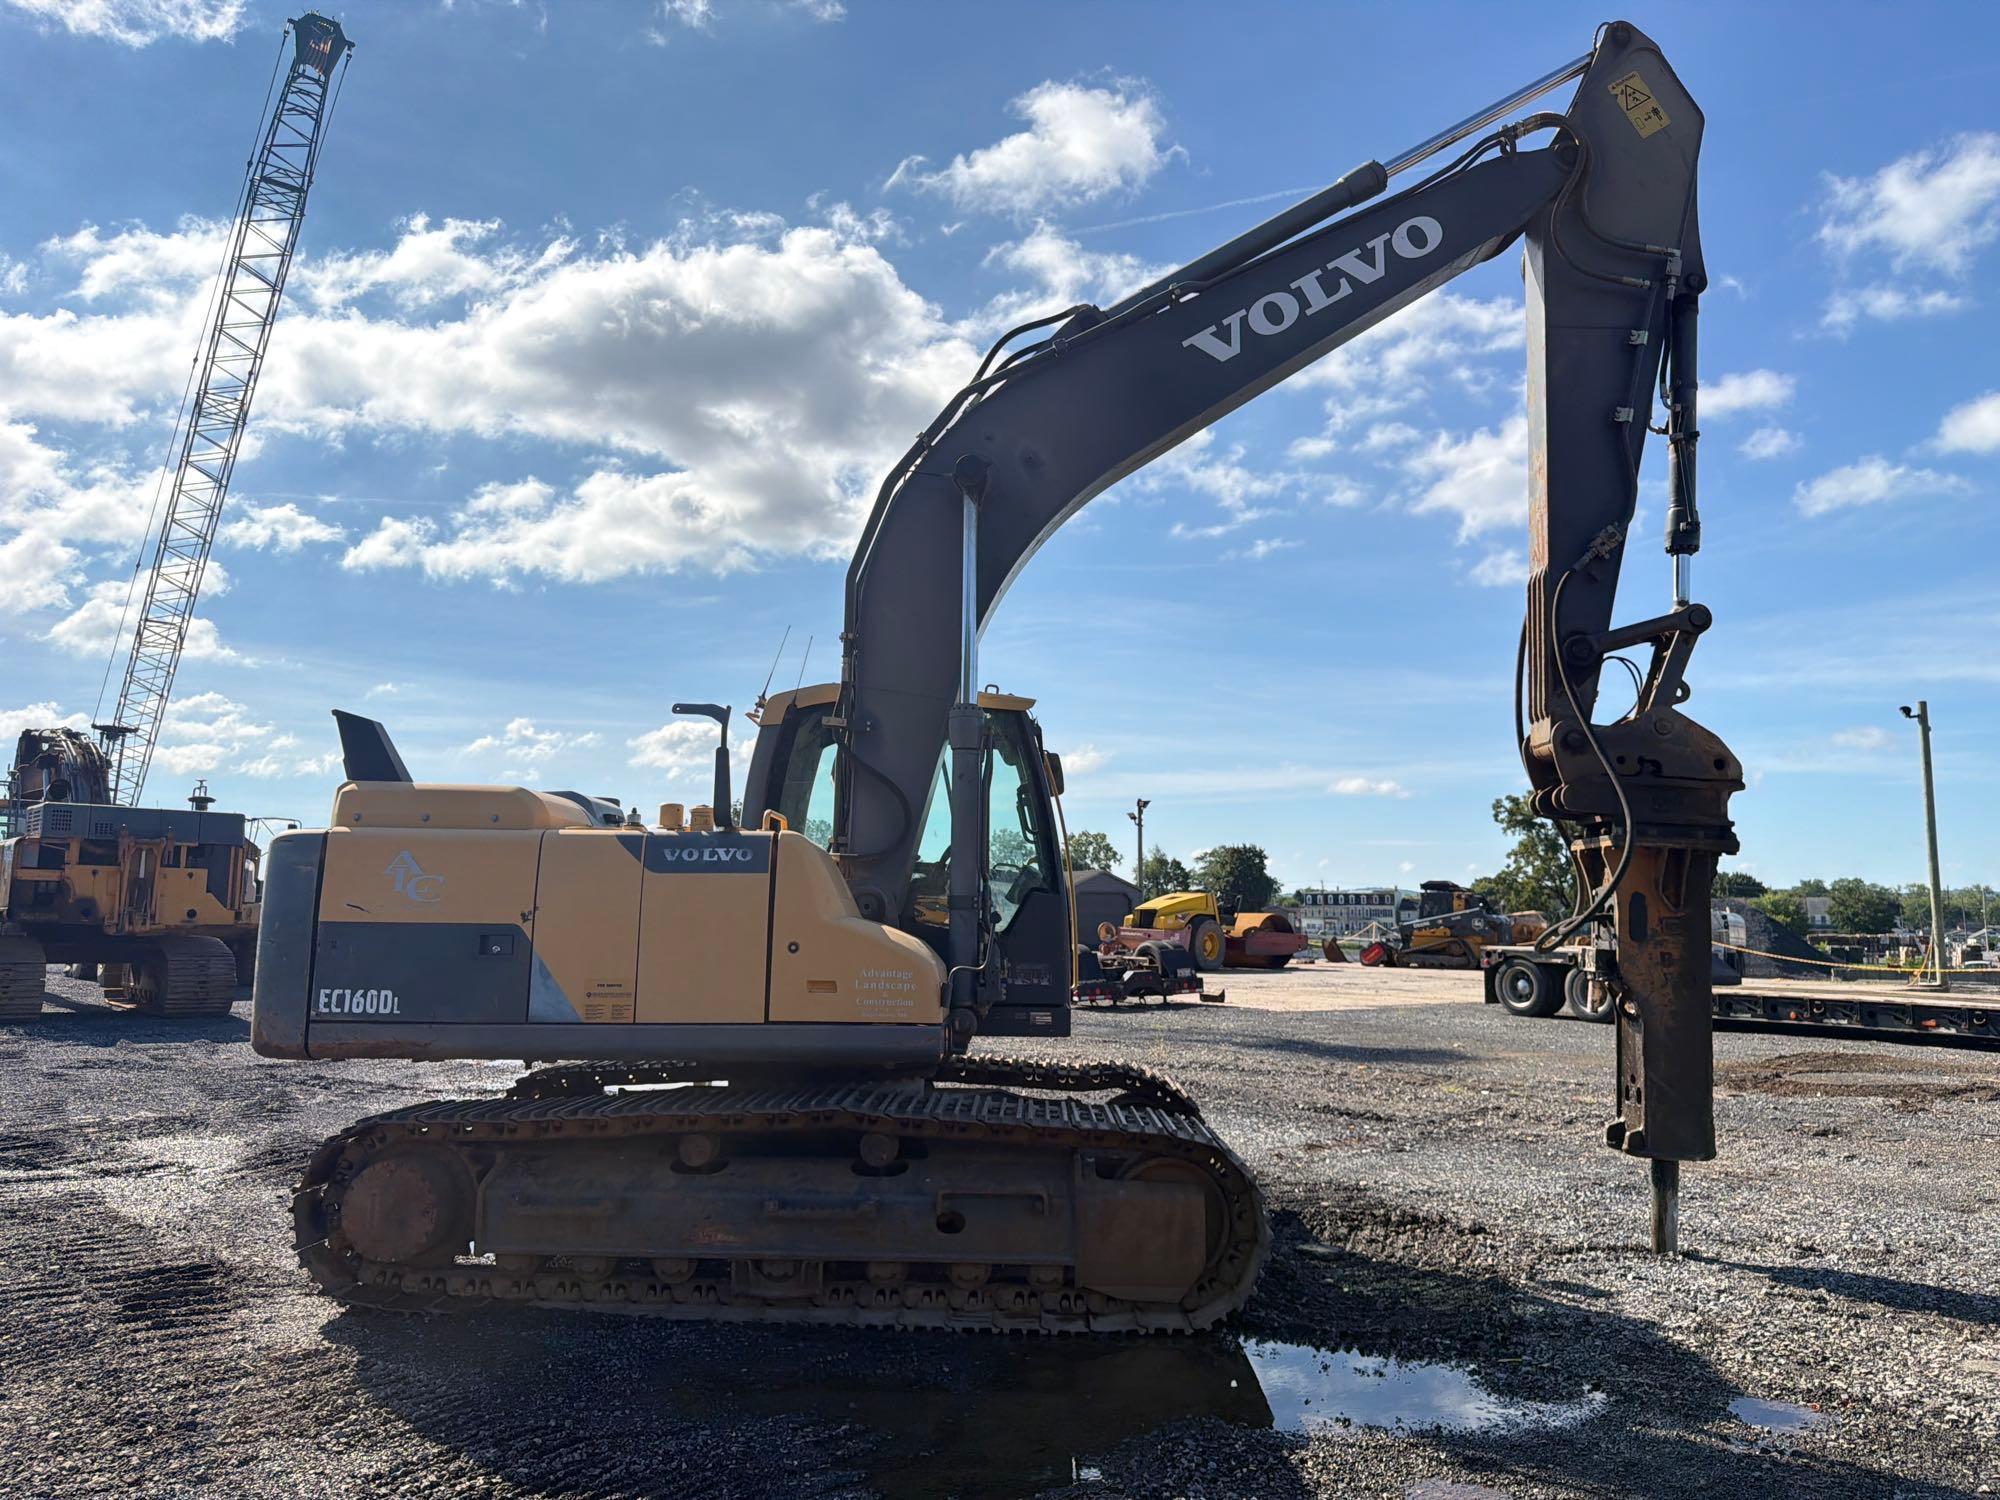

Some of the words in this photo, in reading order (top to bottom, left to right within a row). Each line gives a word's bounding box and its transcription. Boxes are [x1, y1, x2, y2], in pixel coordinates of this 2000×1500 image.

[1181, 216, 1443, 362] VOLVO
[663, 847, 753, 861] VOLVO
[861, 969, 913, 980] Advantage
